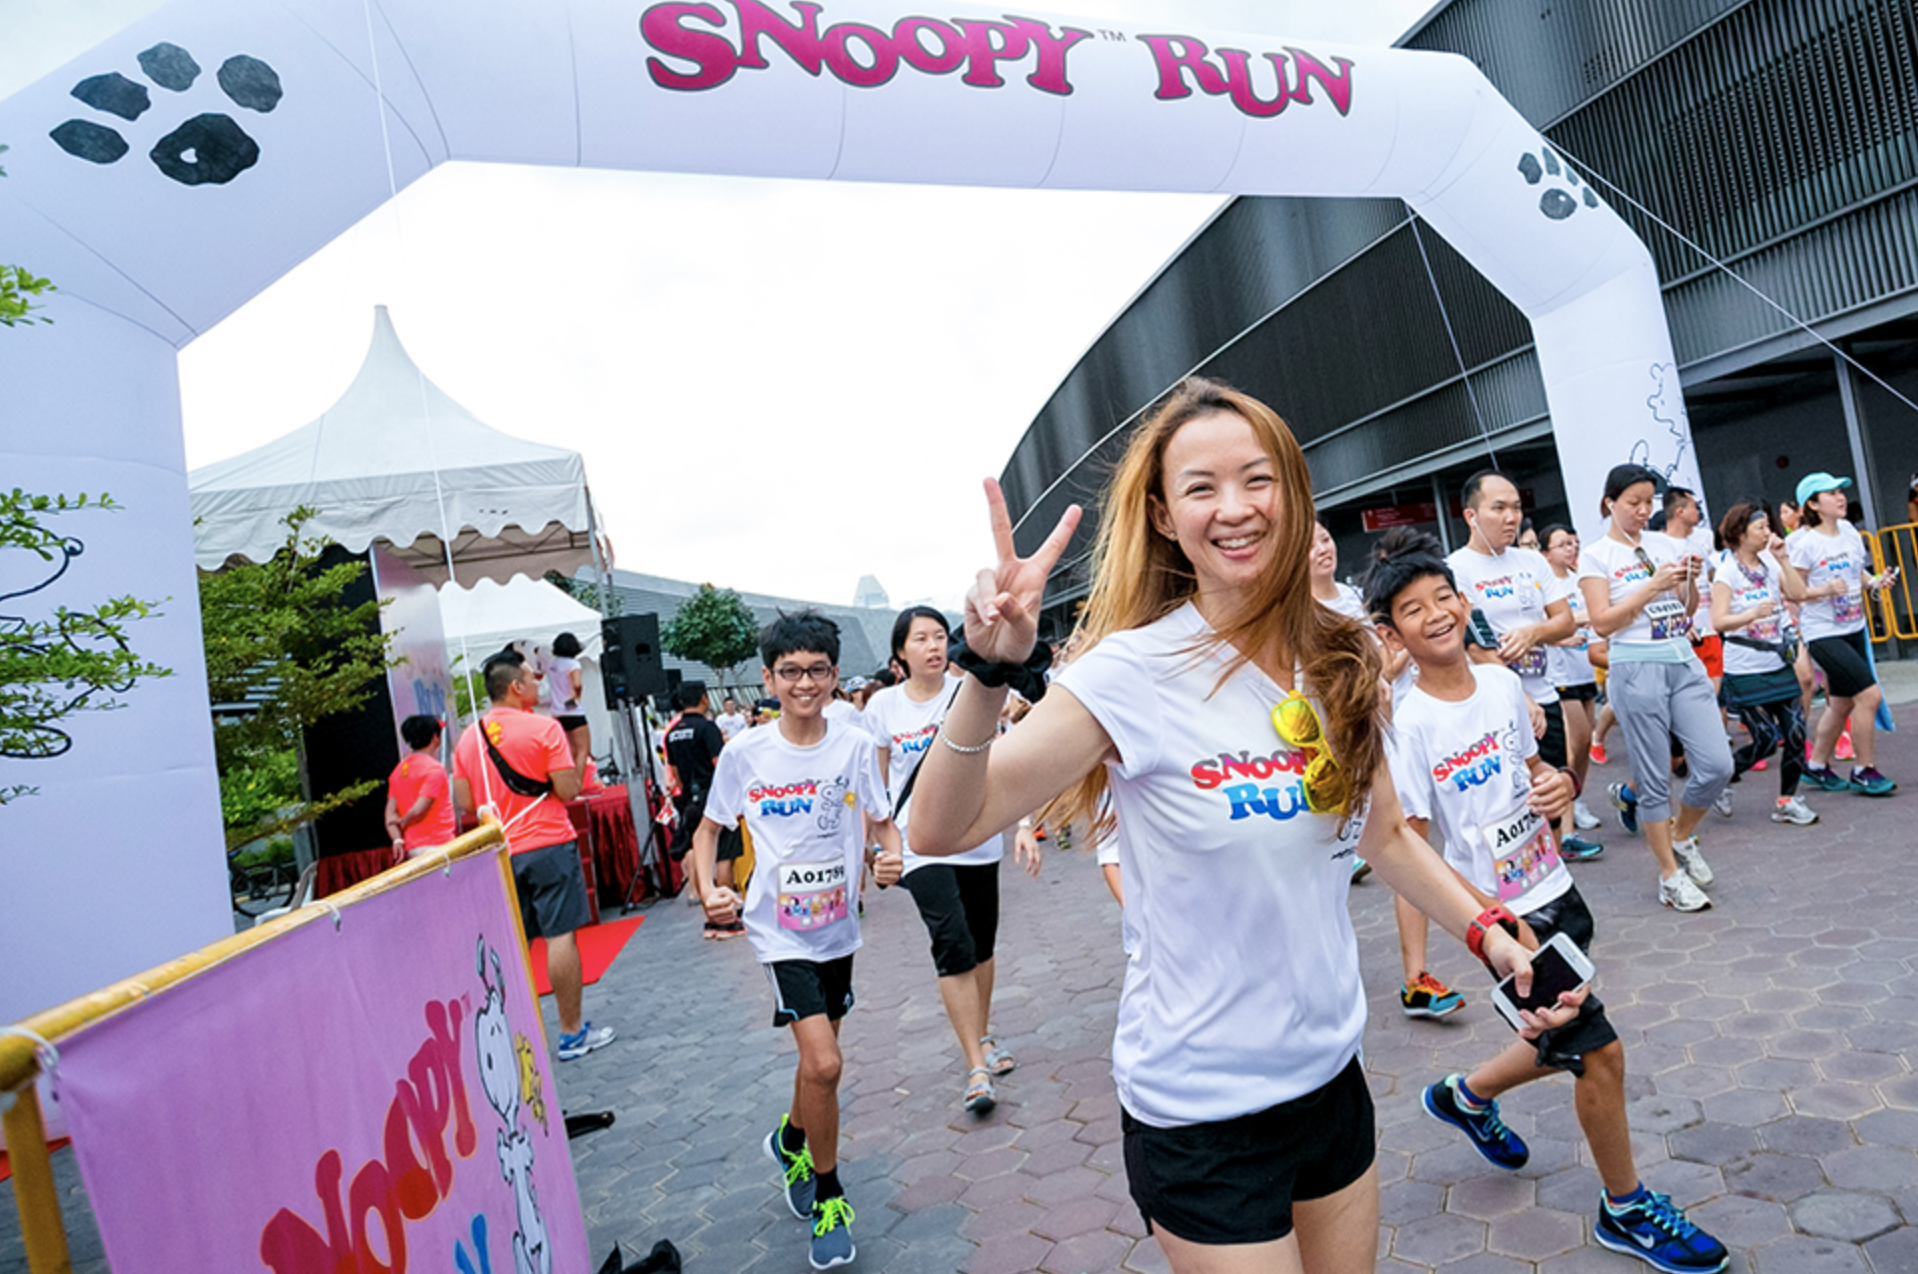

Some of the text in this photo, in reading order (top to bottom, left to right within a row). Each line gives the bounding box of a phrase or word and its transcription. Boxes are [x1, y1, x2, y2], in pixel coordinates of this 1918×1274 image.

[640, 0, 1095, 96] SNOOPY
[1135, 34, 1355, 118] RUN
[1190, 749, 1316, 790] SNOOP
[1432, 730, 1500, 782] SNOOPY
[1452, 755, 1502, 793] RUN
[748, 779, 820, 803] SNOOPY
[760, 797, 814, 817] RUN
[258, 999, 477, 1274] NOOPY
